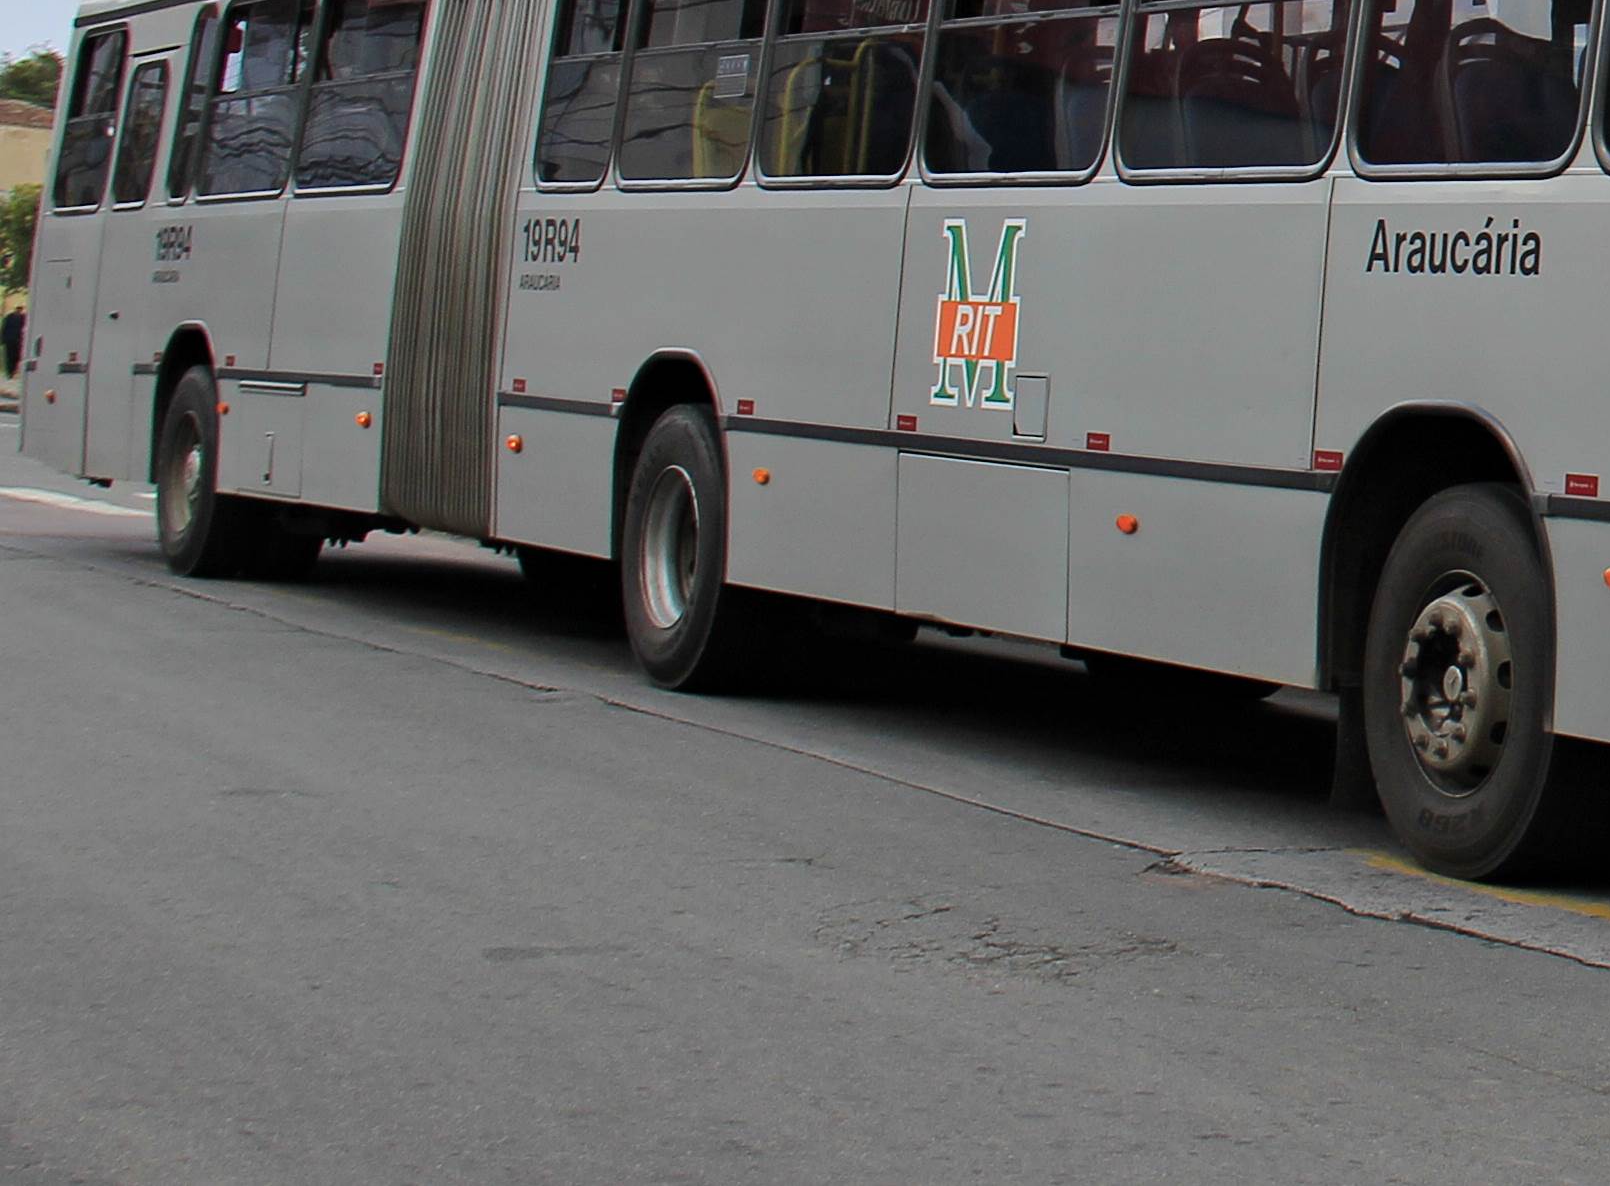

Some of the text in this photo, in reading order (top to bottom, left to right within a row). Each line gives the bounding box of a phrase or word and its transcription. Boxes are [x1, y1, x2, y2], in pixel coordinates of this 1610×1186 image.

[523, 218, 580, 263] 19R94
[1365, 216, 1542, 276] Araucária
[950, 304, 1003, 357] RIT
